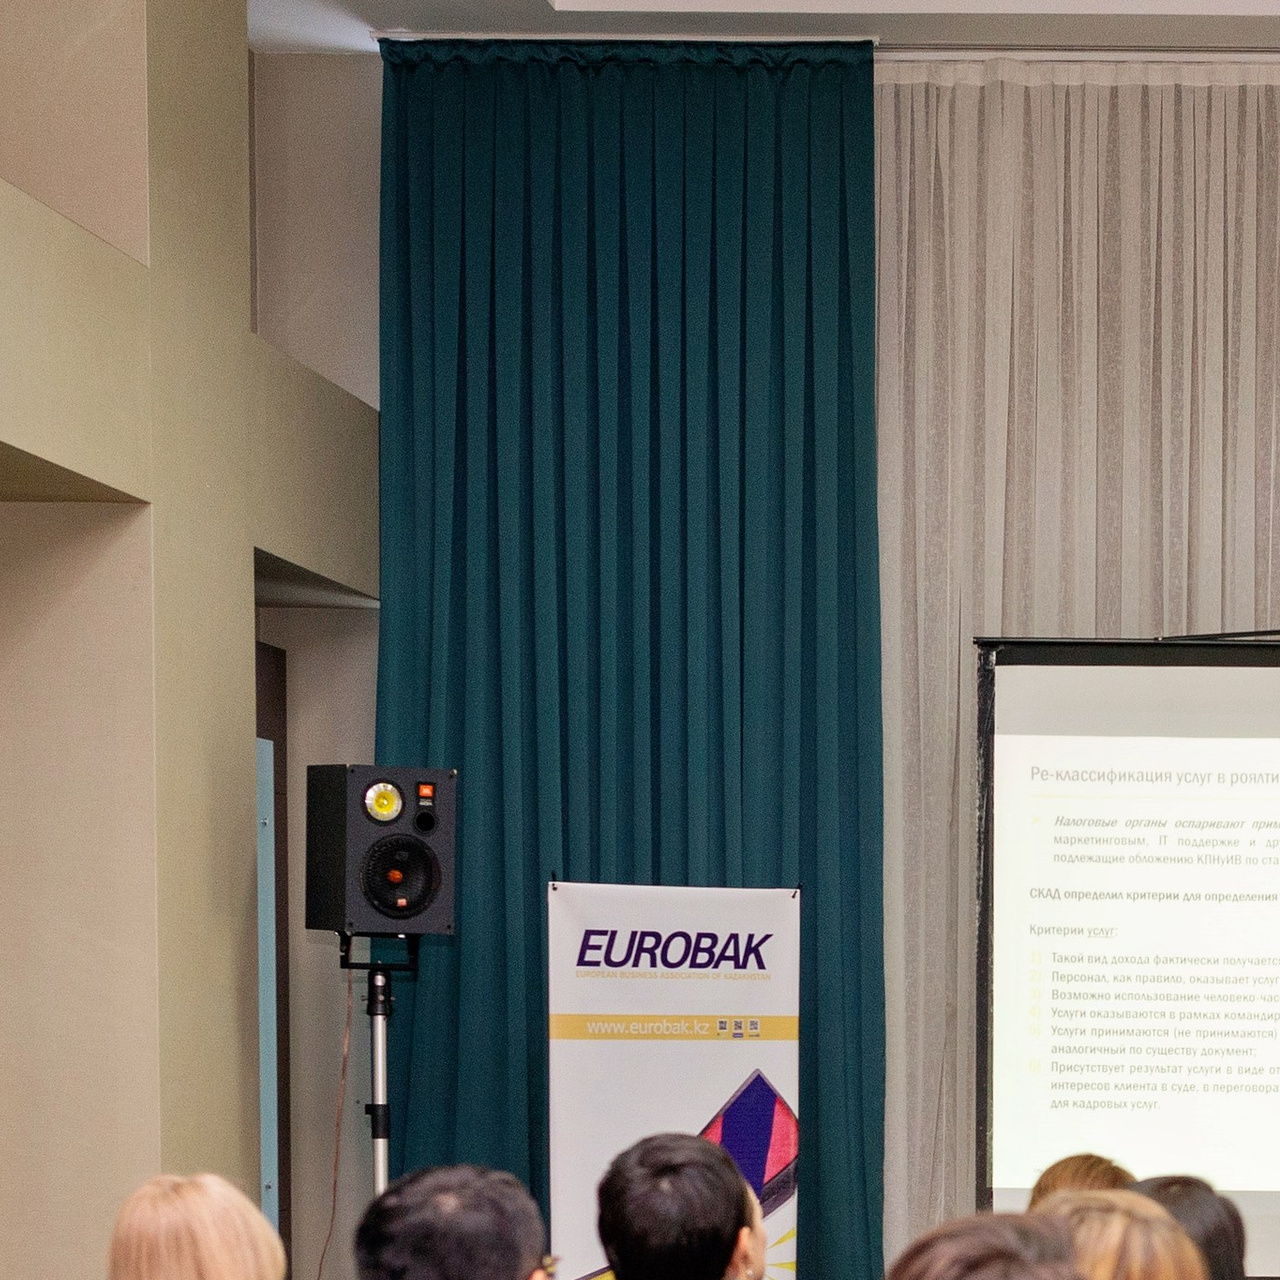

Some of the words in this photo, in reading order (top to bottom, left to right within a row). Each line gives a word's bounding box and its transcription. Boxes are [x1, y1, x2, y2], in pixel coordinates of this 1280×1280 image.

[1030, 765, 1172, 784] Ре-классификация
[1175, 772, 1213, 786] услуг
[1217, 773, 1226, 783] в
[1230, 773, 1280, 786] роялти
[1053, 815, 1119, 827] Налоговые
[1123, 818, 1169, 829] органы
[1173, 819, 1247, 830] оспаривают
[1177, 837, 1240, 848] поддержке
[1053, 853, 1126, 864] подлежащие
[1128, 854, 1194, 864] обложению
[1196, 853, 1242, 866] КПНуИВ
[1245, 856, 1259, 865] по
[1029, 887, 1062, 900] СКАД
[1063, 890, 1124, 901] определил
[1125, 891, 1180, 902] критерии
[1182, 892, 1202, 902] для
[1204, 892, 1278, 903] определения
[1029, 924, 1085, 937] Критерии
[576, 929, 774, 970] EUROBAK
[1051, 951, 1084, 963] Такой
[1087, 955, 1108, 965] вид
[1110, 955, 1150, 965] дохода
[1152, 954, 1220, 965] фактически
[575, 970, 618, 979] EUROPEAN
[619, 971, 657, 979] BUSINESS
[658, 971, 710, 980] ASSOCIATION
[1112, 974, 1133, 982] как
[1135, 974, 1186, 984] правило,
[1189, 975, 1250, 984] оказывает
[1051, 988, 1112, 1000] Возможно
[1114, 992, 1201, 1001] использование
[1051, 1006, 1087, 1020] Услуги
[1089, 1010, 1166, 1019] оказываются
[1169, 1010, 1176, 1019] в
[1178, 1011, 1221, 1021] рамках
[586, 1019, 710, 1036] www.eurobak.kz
[1050, 1024, 1087, 1038] Услуги
[1090, 1027, 1170, 1038] принимаются
[1173, 1028, 1191, 1038] (не
[1195, 1028, 1278, 1039] принимаются)
[1050, 1044, 1126, 1054] аналогичный
[1129, 1046, 1143, 1054] по
[1145, 1046, 1198, 1057] существу
[1050, 1060, 1125, 1075] Присутствует
[1129, 1064, 1183, 1075] результат
[1187, 1065, 1222, 1076] услуги
[1226, 1065, 1233, 1074] в
[1237, 1066, 1265, 1075] виде
[1050, 1081, 1111, 1092] интересов
[1113, 1082, 1158, 1091] клиента
[1160, 1082, 1168, 1091] в
[1202, 1083, 1210, 1093] в
[1050, 1099, 1070, 1109] для
[1072, 1099, 1128, 1110] кадровых
